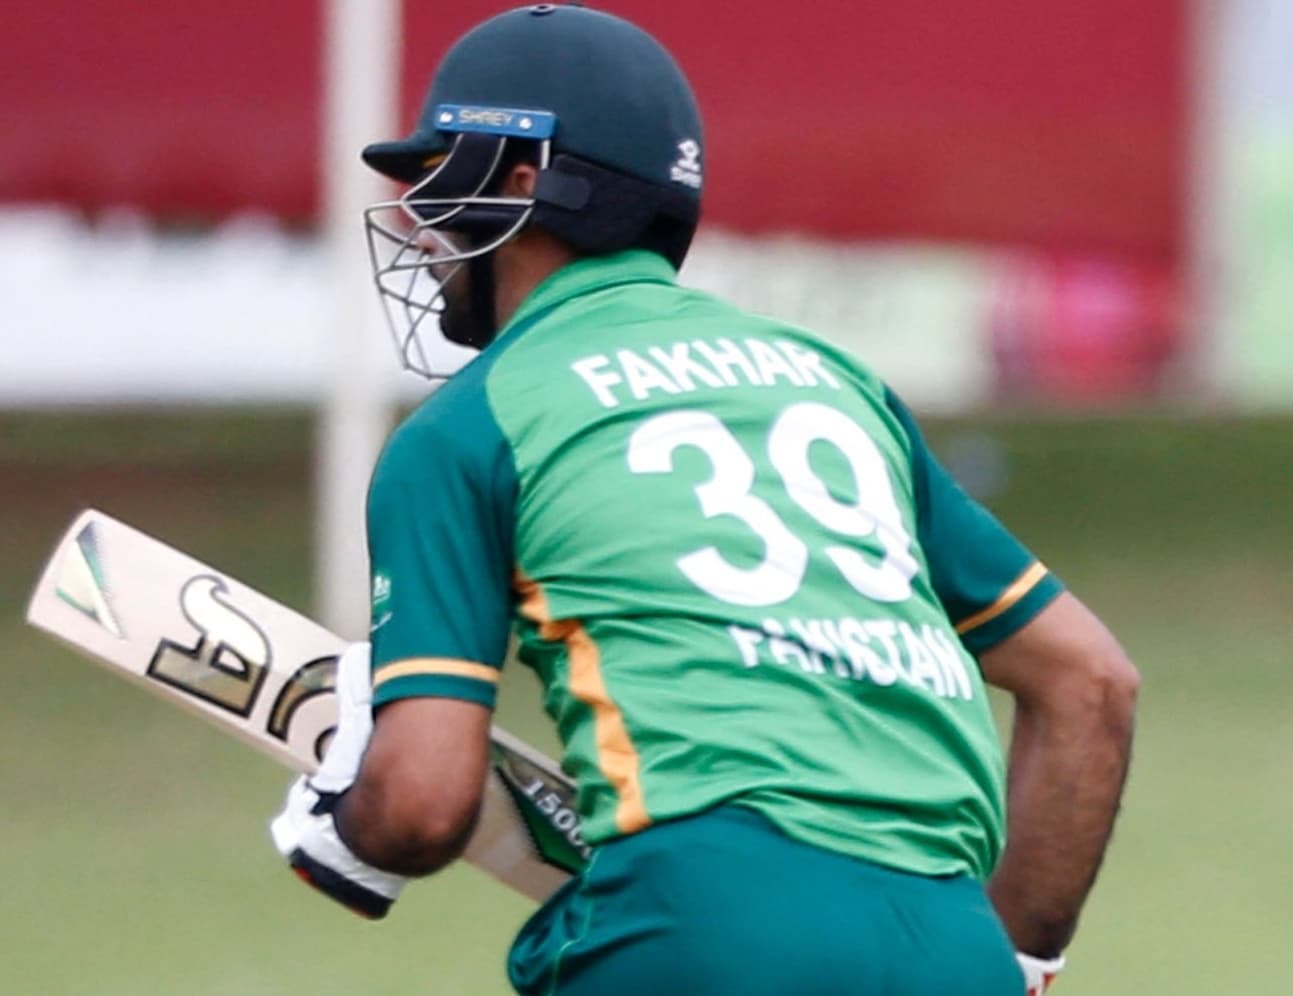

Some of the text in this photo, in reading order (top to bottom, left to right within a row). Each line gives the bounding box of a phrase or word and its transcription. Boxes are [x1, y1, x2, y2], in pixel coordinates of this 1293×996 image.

[571, 337, 841, 408] FAKHAR
[627, 402, 919, 607] 39
[521, 778, 593, 860] 1500
